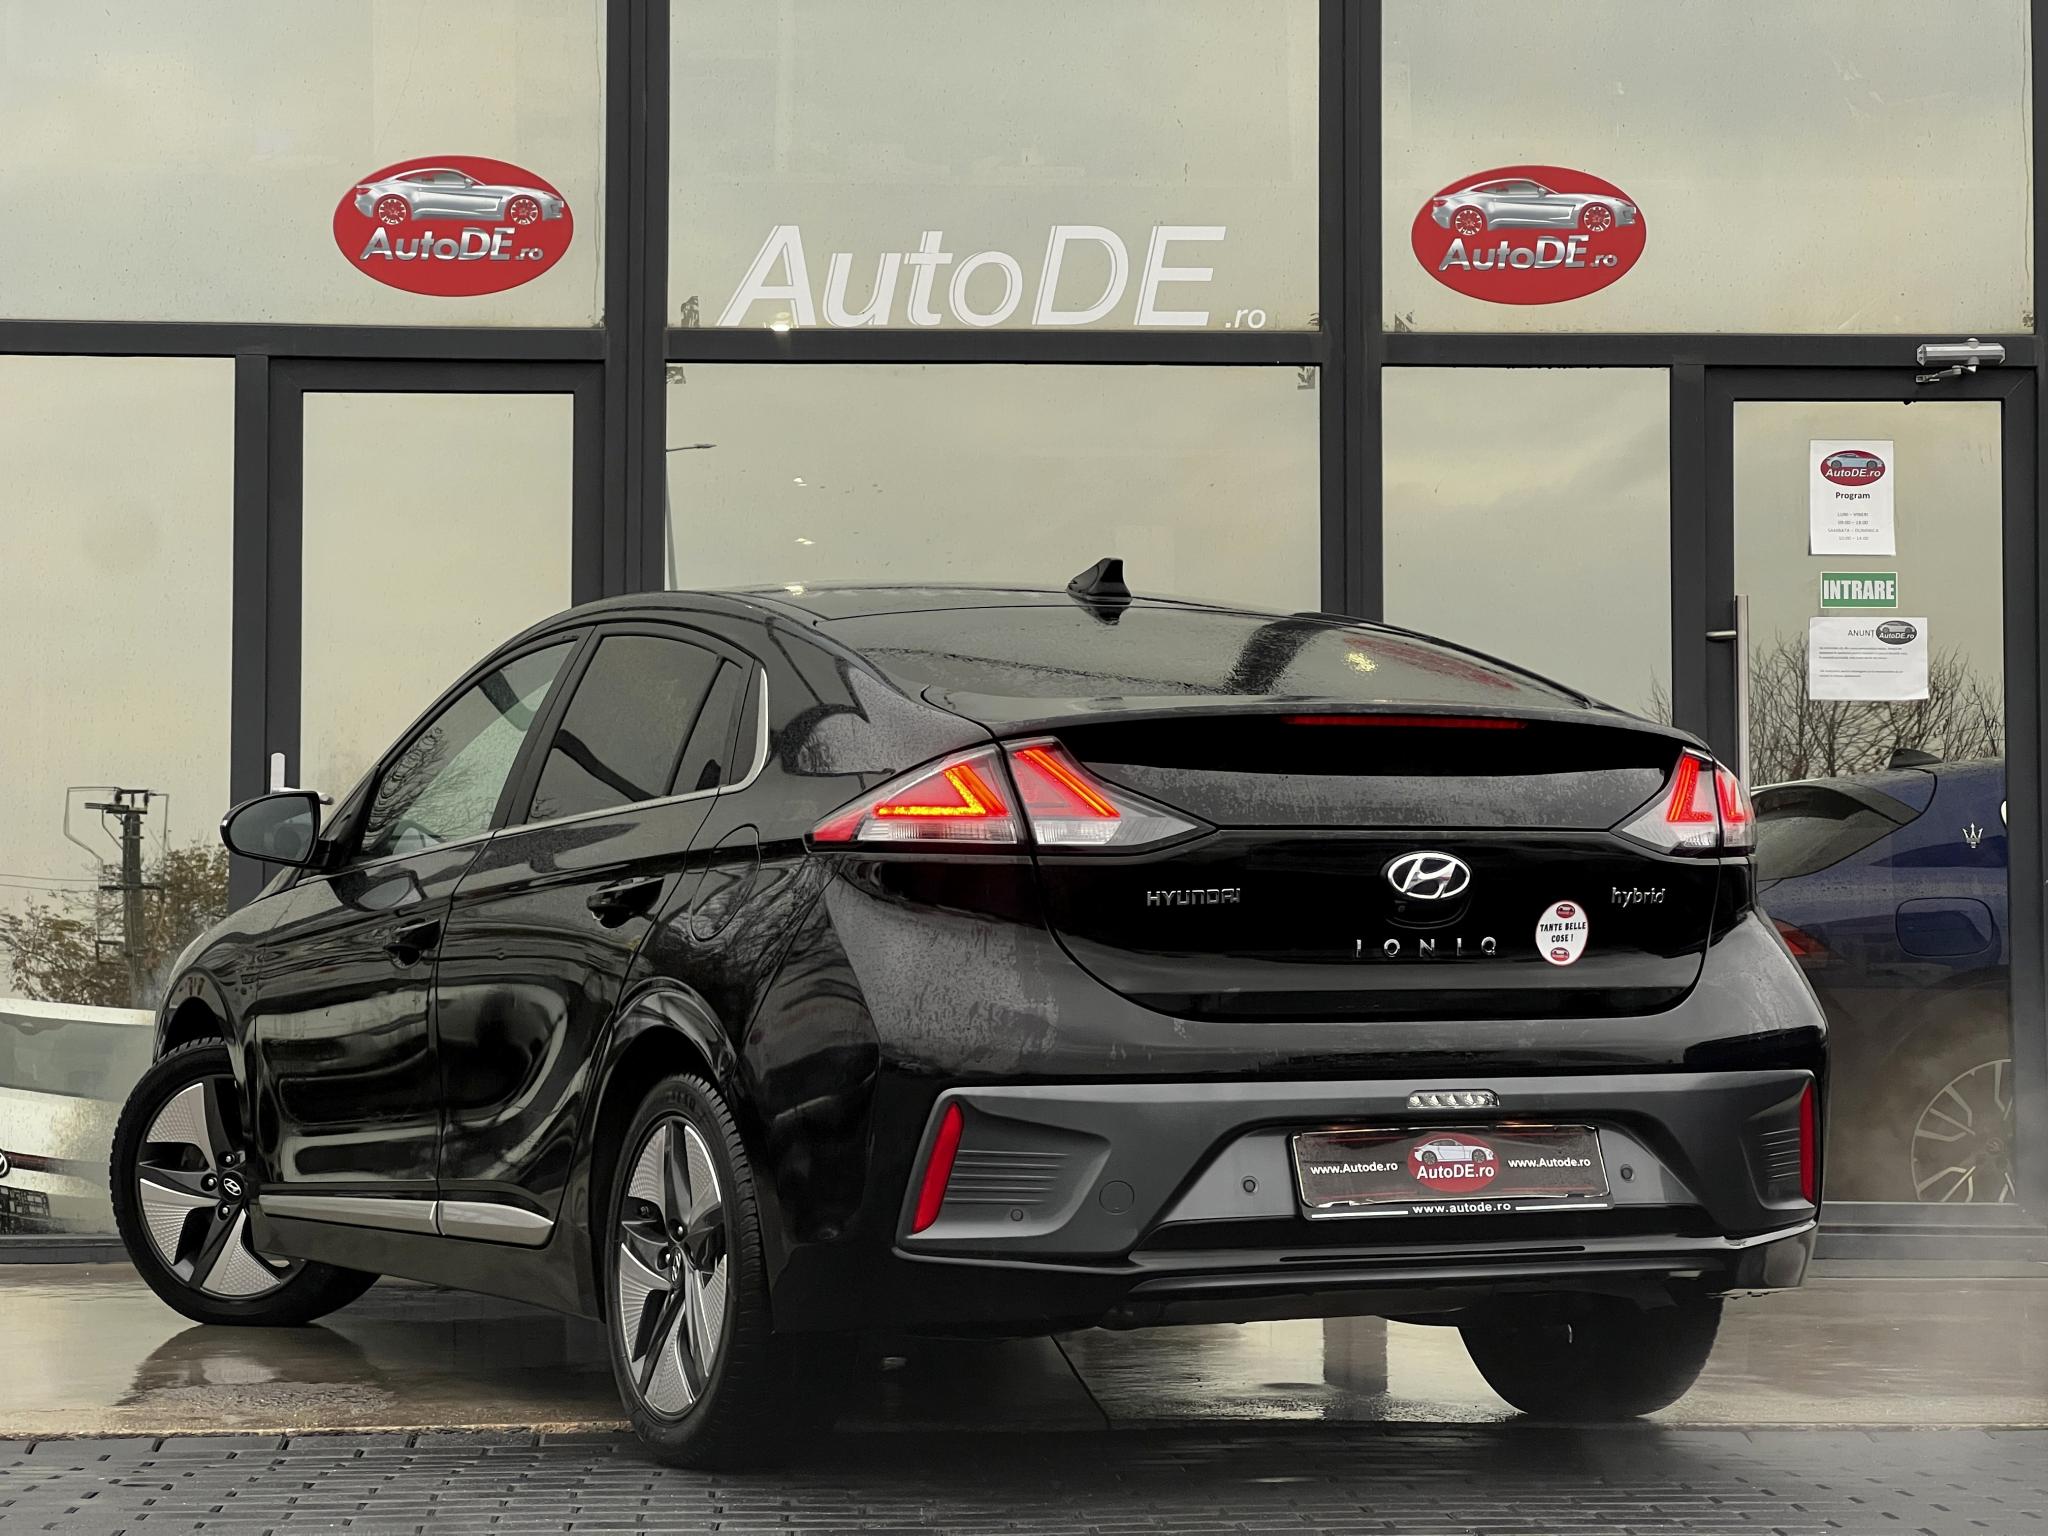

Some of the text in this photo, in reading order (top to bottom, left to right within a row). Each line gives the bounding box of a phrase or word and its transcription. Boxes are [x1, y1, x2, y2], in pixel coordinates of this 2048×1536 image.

[1825, 468, 1881, 478] AutoDE.ro
[1835, 491, 1871, 501] Program
[1823, 579, 1895, 600] INTRARE
[1146, 887, 1241, 907] HYUNDAI
[1611, 886, 1666, 909] hybrid
[1539, 921, 1587, 932] TANTE BELLE
[1551, 934, 1569, 943] COSE
[1355, 936, 1497, 958] IONIQ
[1310, 1161, 1399, 1175] www.Autode.ro
[1507, 1156, 1592, 1168] www.Autode.ro
[1416, 1163, 1495, 1180] AutoDE.ro
[1412, 1202, 1512, 1214] www.autode.ro
